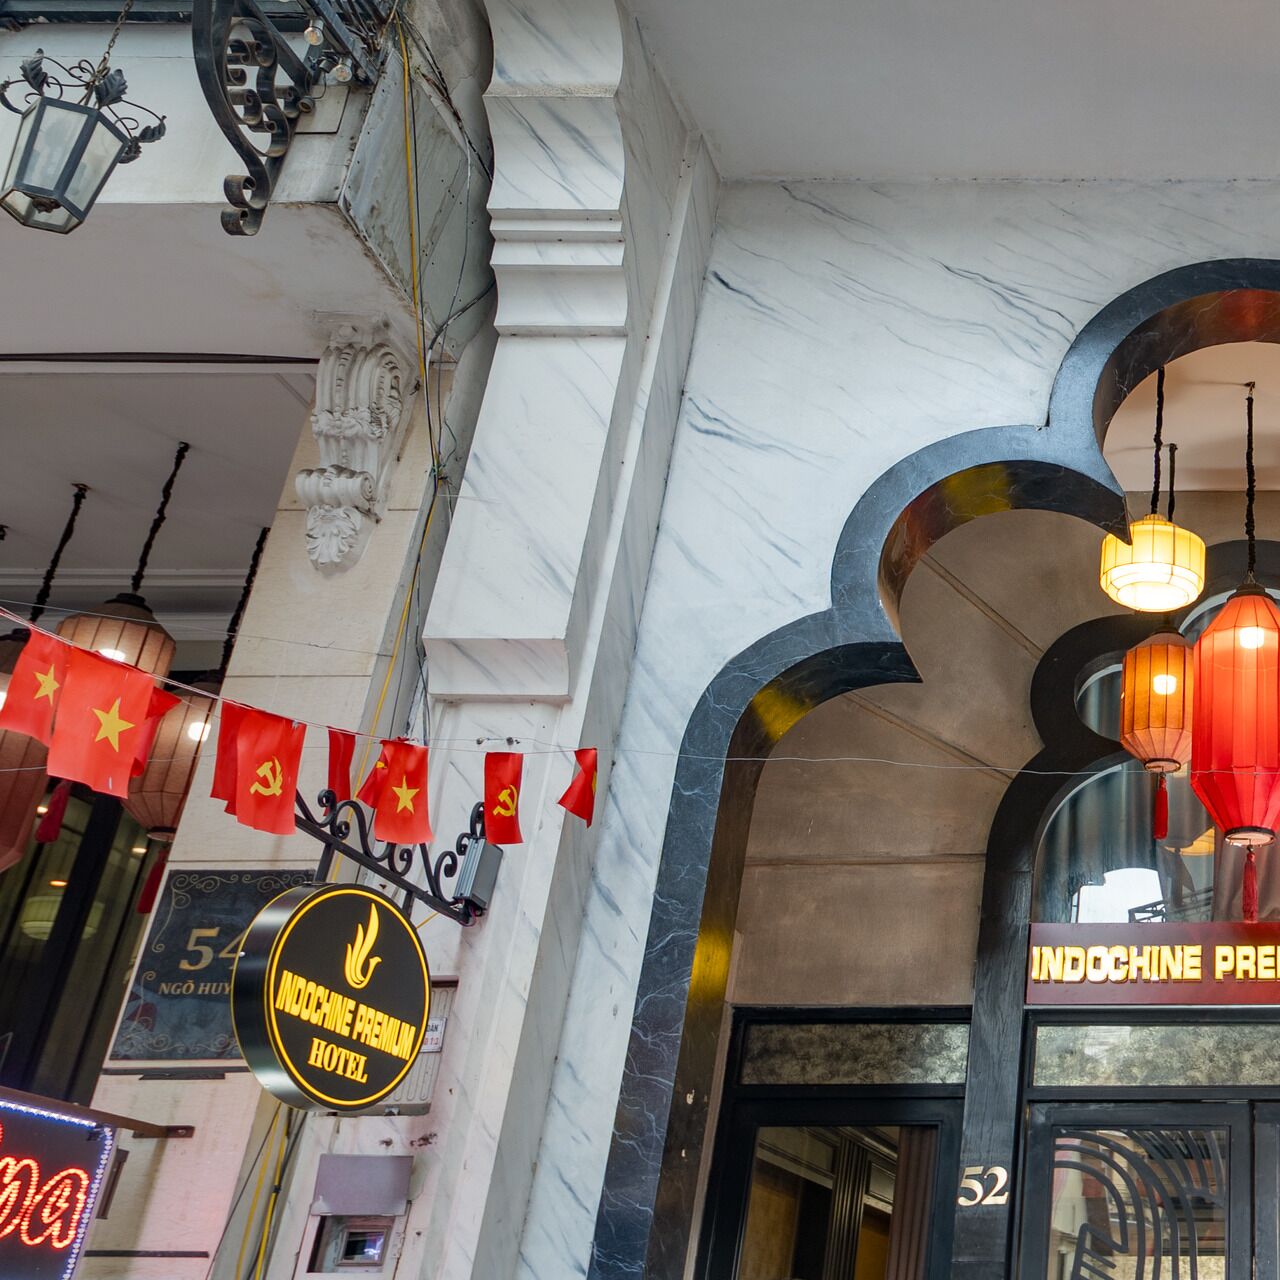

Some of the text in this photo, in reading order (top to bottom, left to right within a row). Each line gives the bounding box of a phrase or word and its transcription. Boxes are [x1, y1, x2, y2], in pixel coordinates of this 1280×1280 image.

[1031, 945, 1202, 982] INDOCHINE
[275, 970, 416, 1061] INDOCHINE PREMIUM
[307, 1037, 369, 1084] HOTEL
[957, 1165, 1009, 1207] 52
